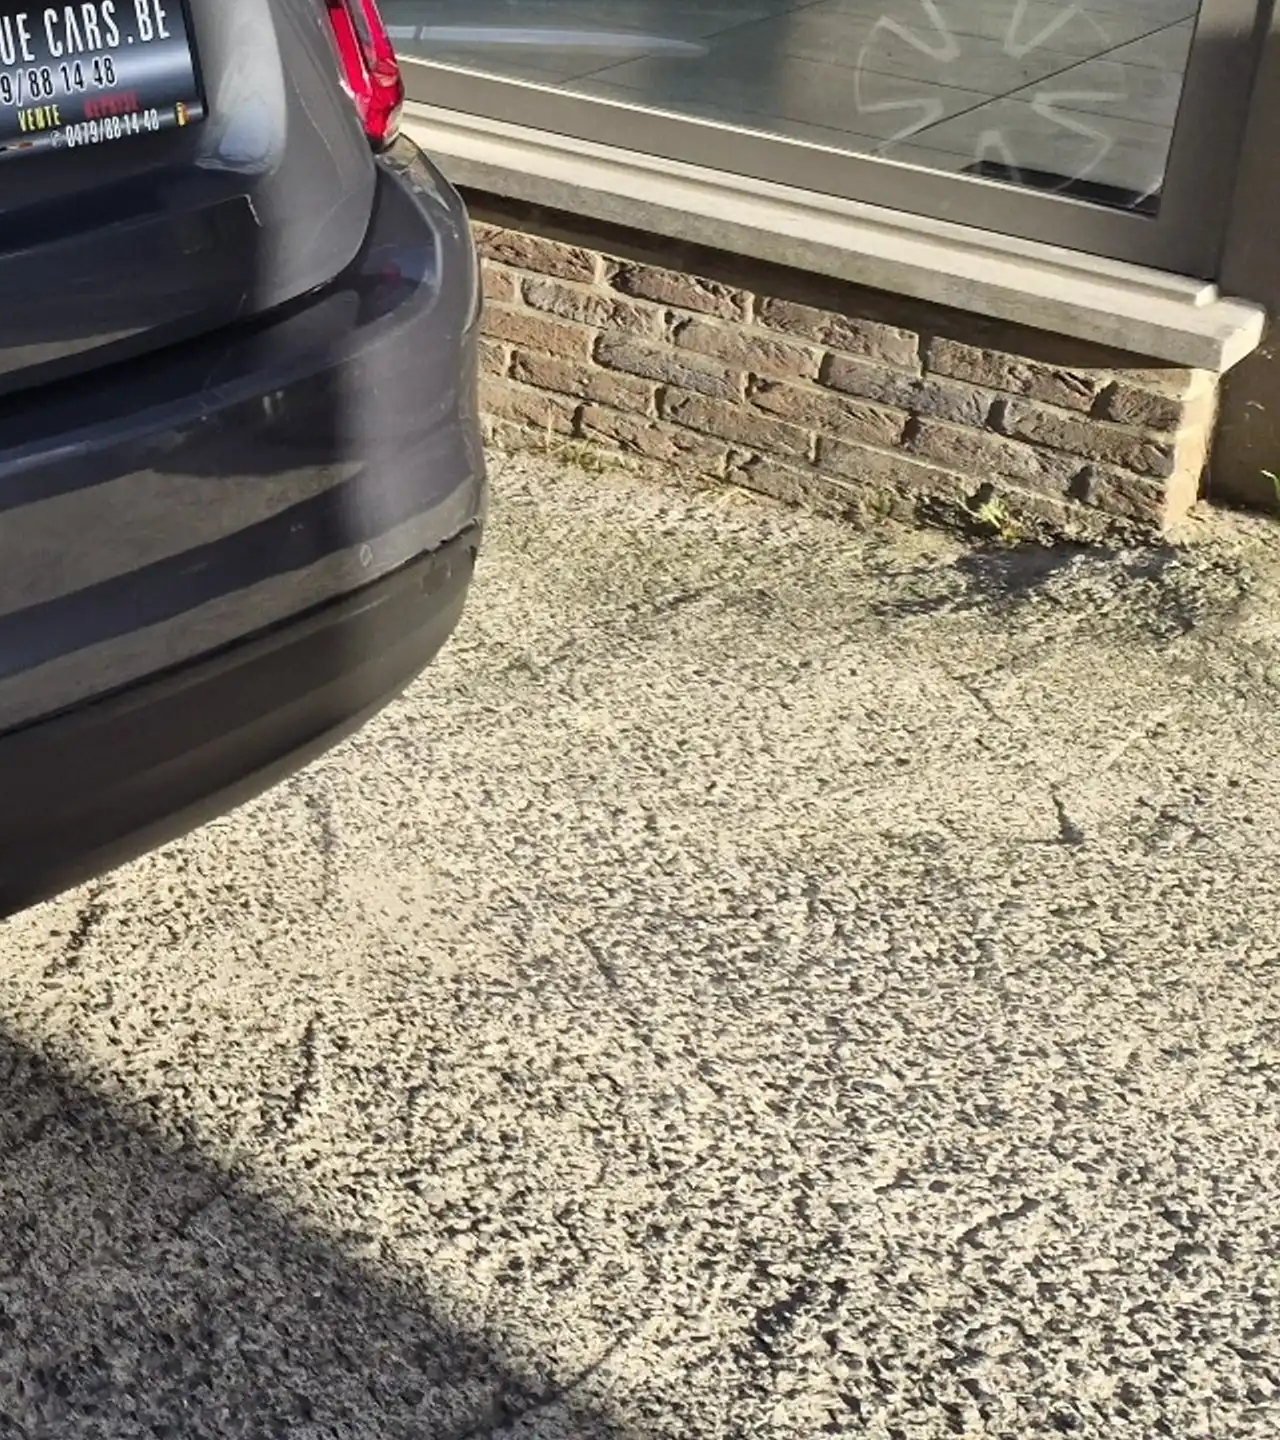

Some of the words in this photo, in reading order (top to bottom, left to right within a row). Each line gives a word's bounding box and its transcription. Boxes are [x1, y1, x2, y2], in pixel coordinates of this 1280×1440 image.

[59, 59, 86, 94] 14
[92, 54, 118, 88] 48
[17, 103, 61, 133] VENTE
